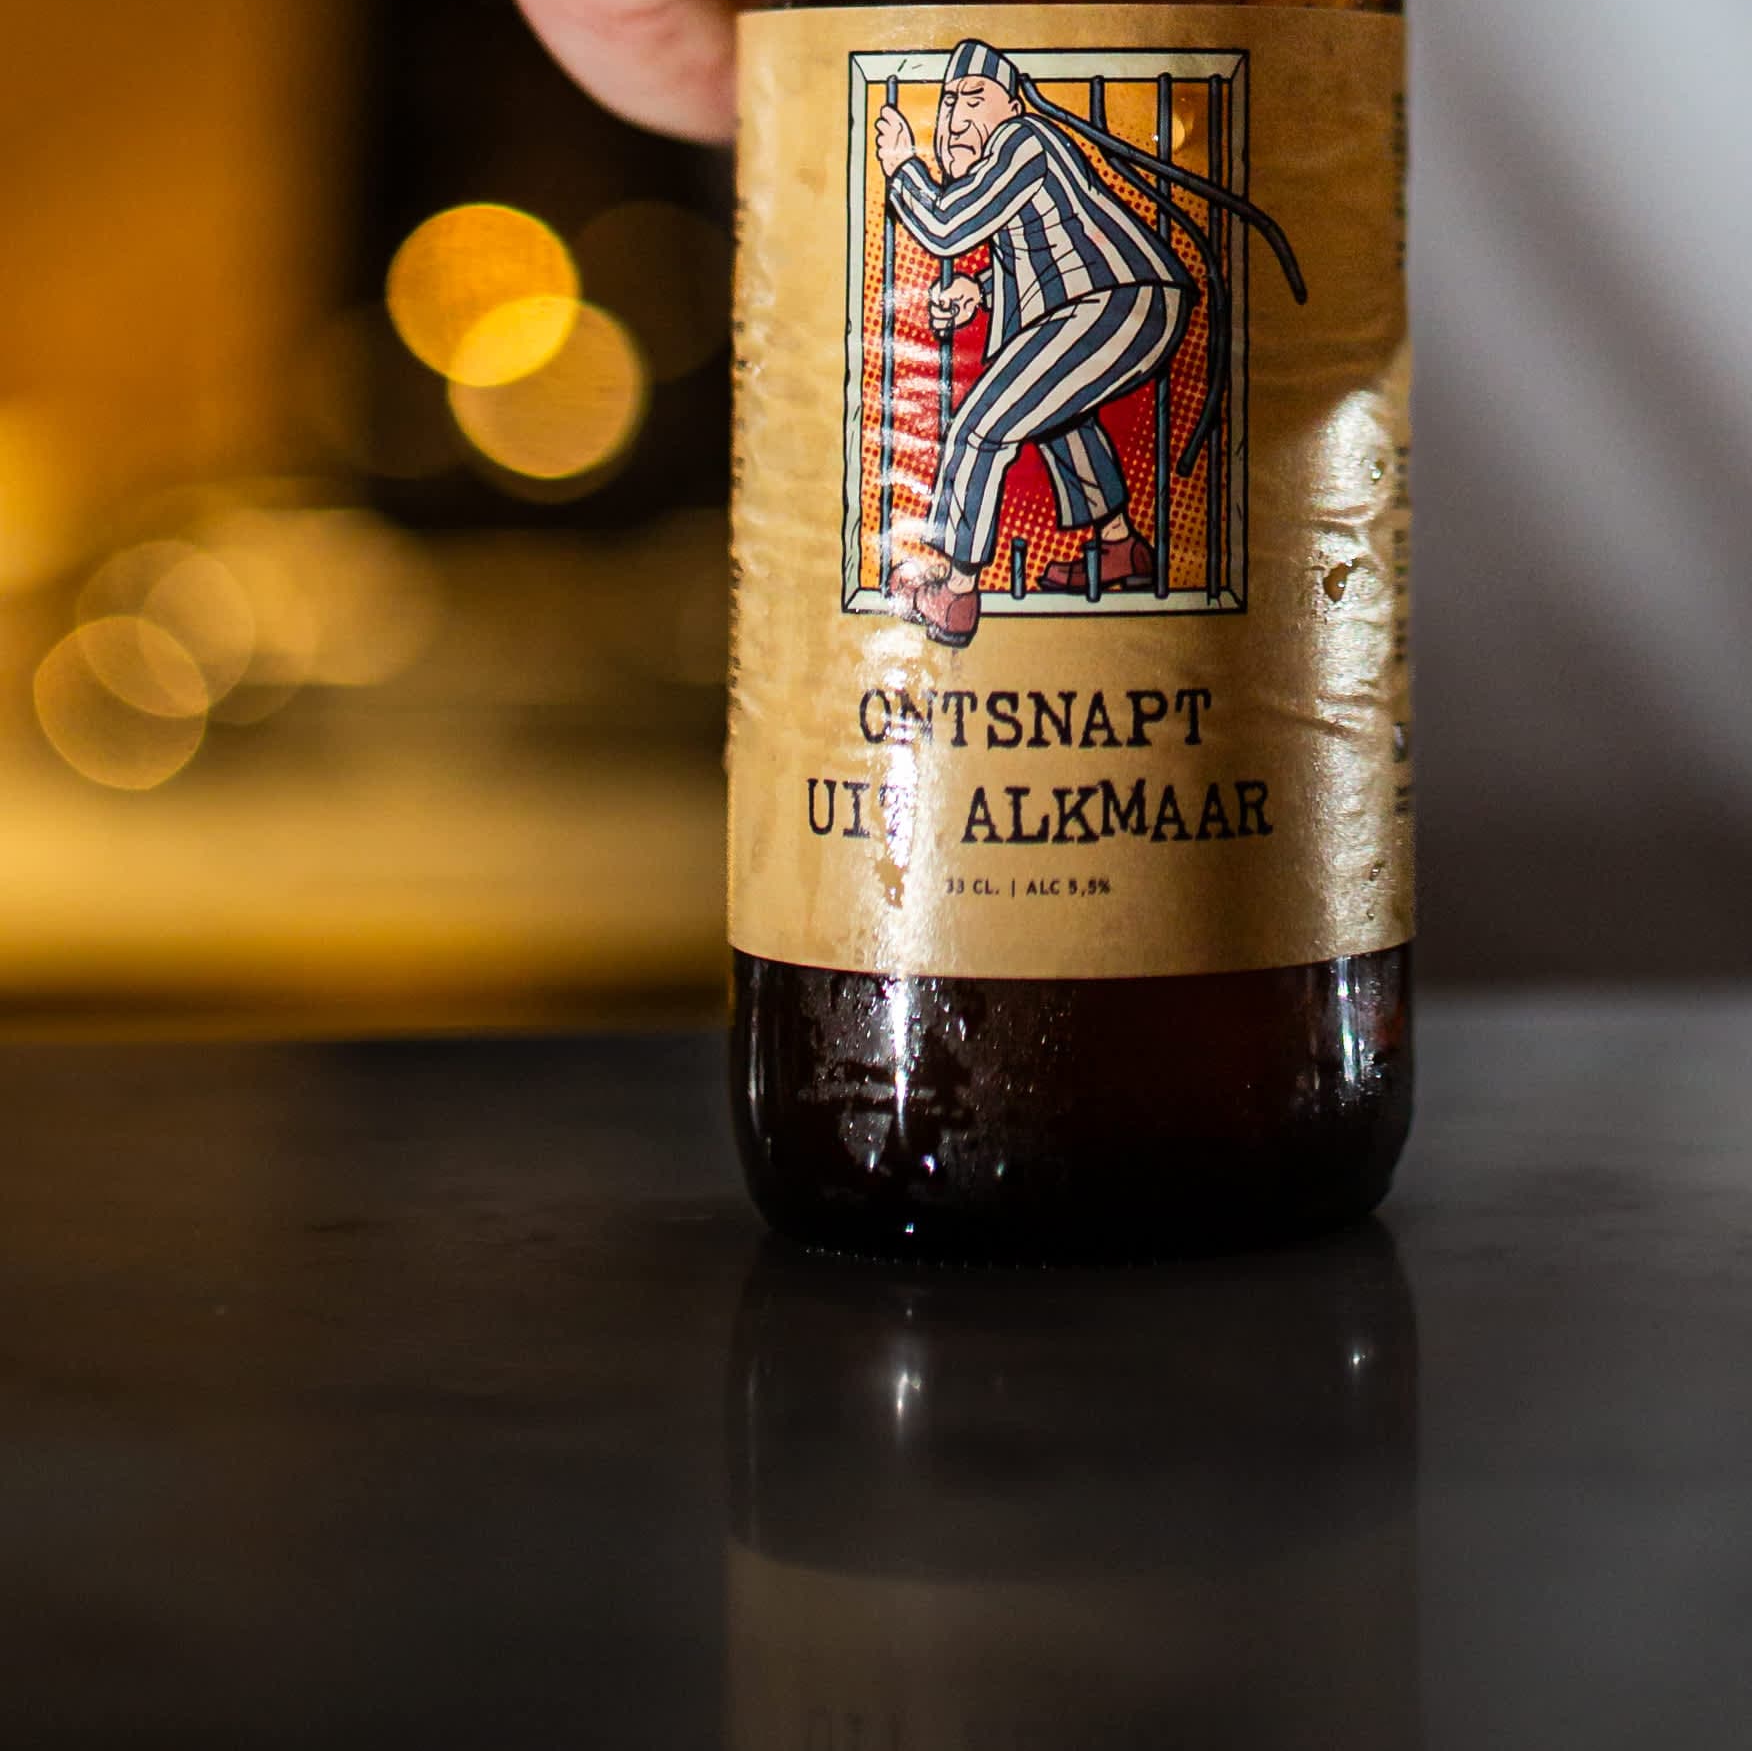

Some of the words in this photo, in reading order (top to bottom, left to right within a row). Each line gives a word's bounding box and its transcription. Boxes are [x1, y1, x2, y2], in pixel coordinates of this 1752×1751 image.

[859, 688, 1212, 749] ONTSNAPT
[961, 778, 1273, 845] ALKMAAR
[972, 878, 1000, 895] CL.
[1026, 878, 1060, 895] ALC
